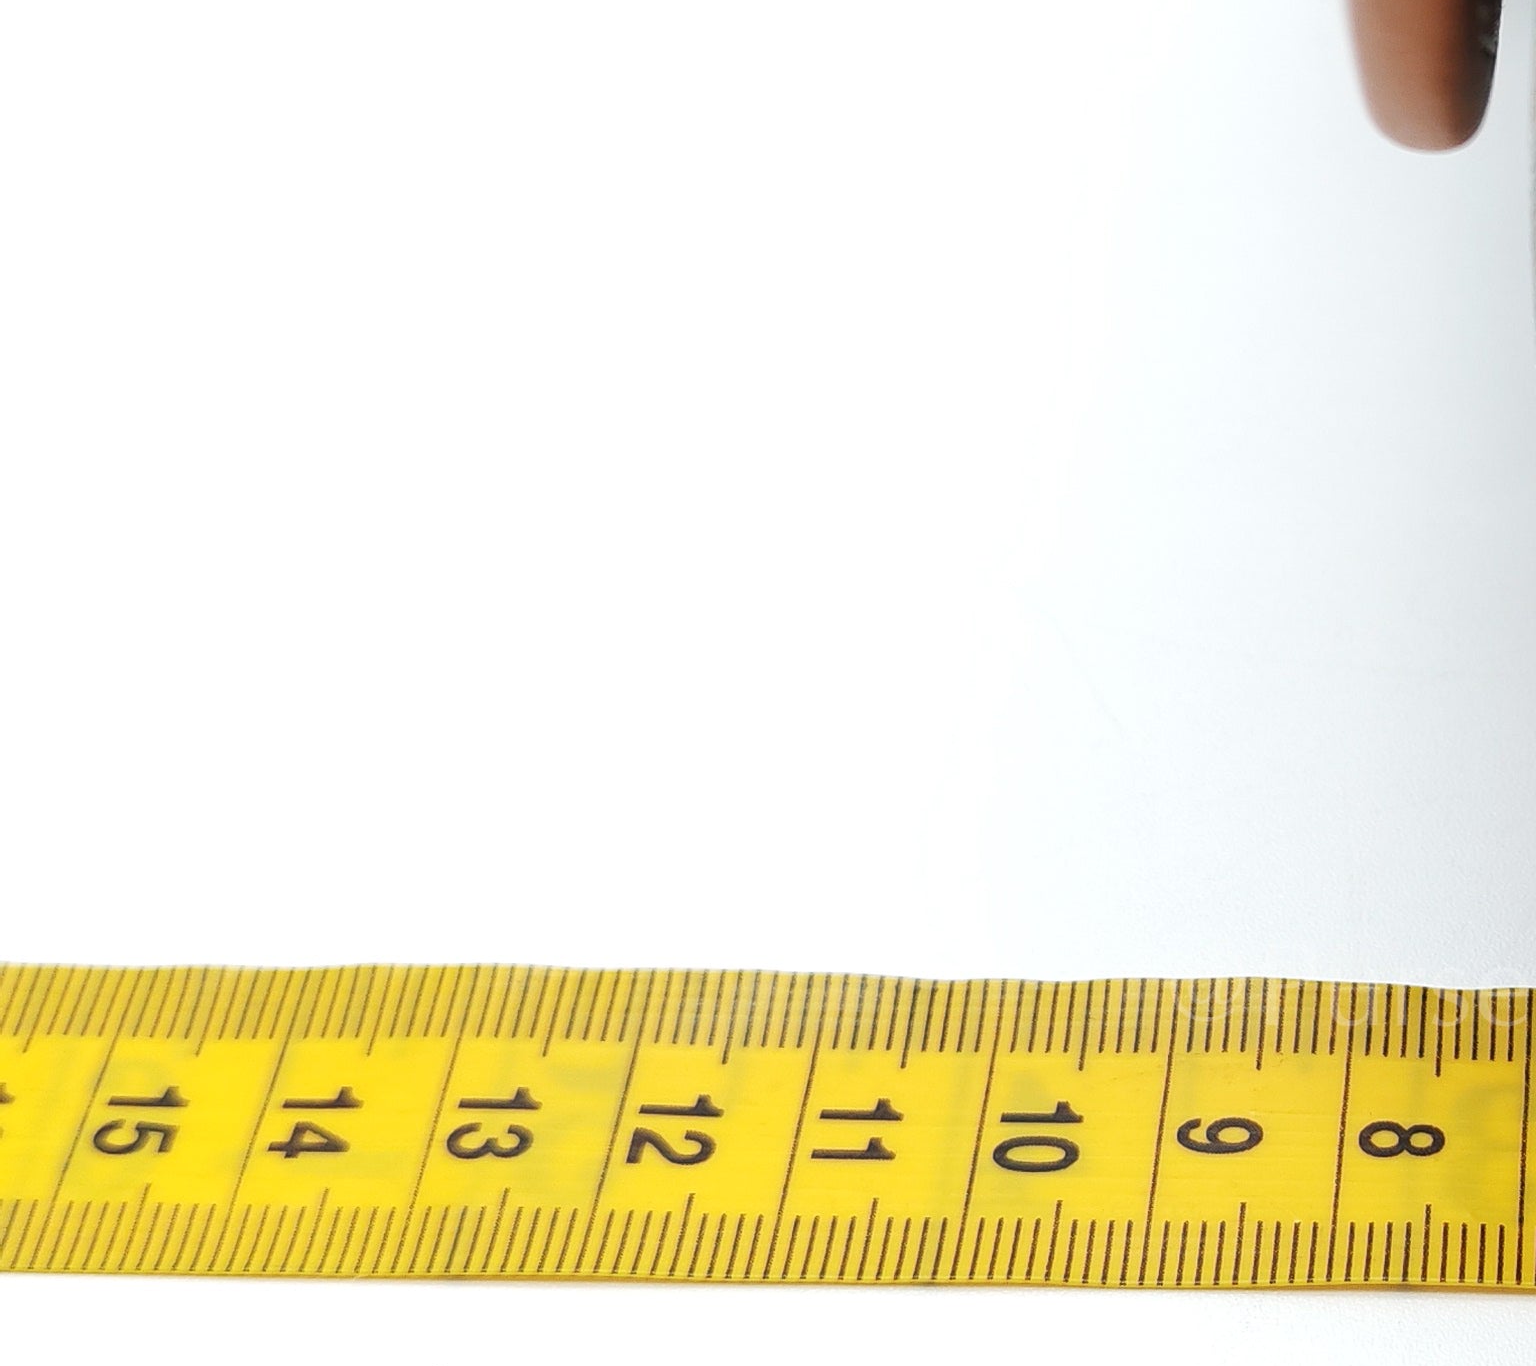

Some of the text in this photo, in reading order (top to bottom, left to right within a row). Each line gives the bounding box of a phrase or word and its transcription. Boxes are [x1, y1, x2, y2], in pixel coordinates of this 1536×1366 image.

[92, 1085, 189, 1156] 15
[267, 1085, 365, 1160] 14
[446, 1086, 543, 1161] 13
[625, 1093, 725, 1167] 12
[810, 1098, 904, 1161] 11
[992, 1100, 1084, 1173] 10
[1176, 1116, 1264, 1155] 9
[1358, 1120, 1446, 1158] 8
